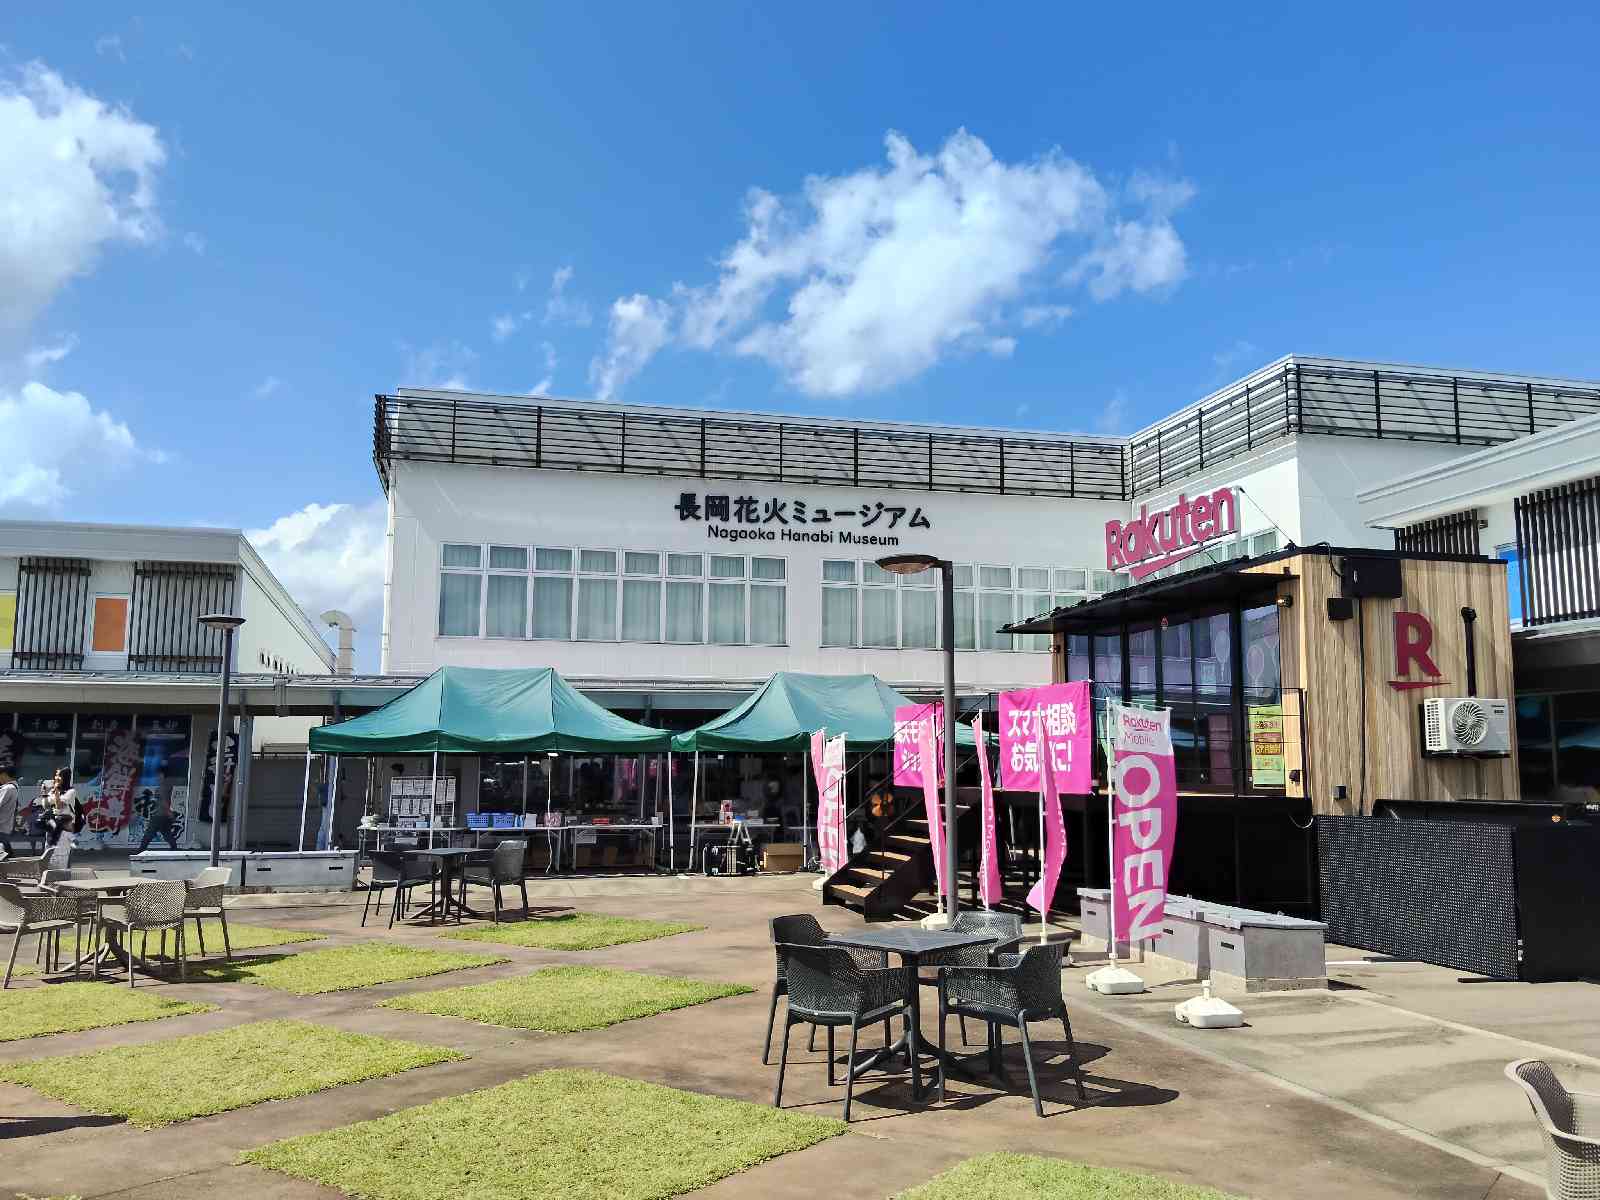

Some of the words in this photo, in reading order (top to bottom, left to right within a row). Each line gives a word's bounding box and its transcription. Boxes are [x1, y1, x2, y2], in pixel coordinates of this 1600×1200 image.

[674, 493, 931, 529] 長岡花火ミュージアム
[707, 525, 775, 542] Nagaoka
[780, 529, 833, 544] Hanabi
[839, 531, 899, 546] Museum
[1105, 486, 1237, 572] Rakuten
[1393, 611, 1441, 678] R
[1010, 739, 1073, 773] お気に!
[1115, 754, 1165, 943] OPEN
